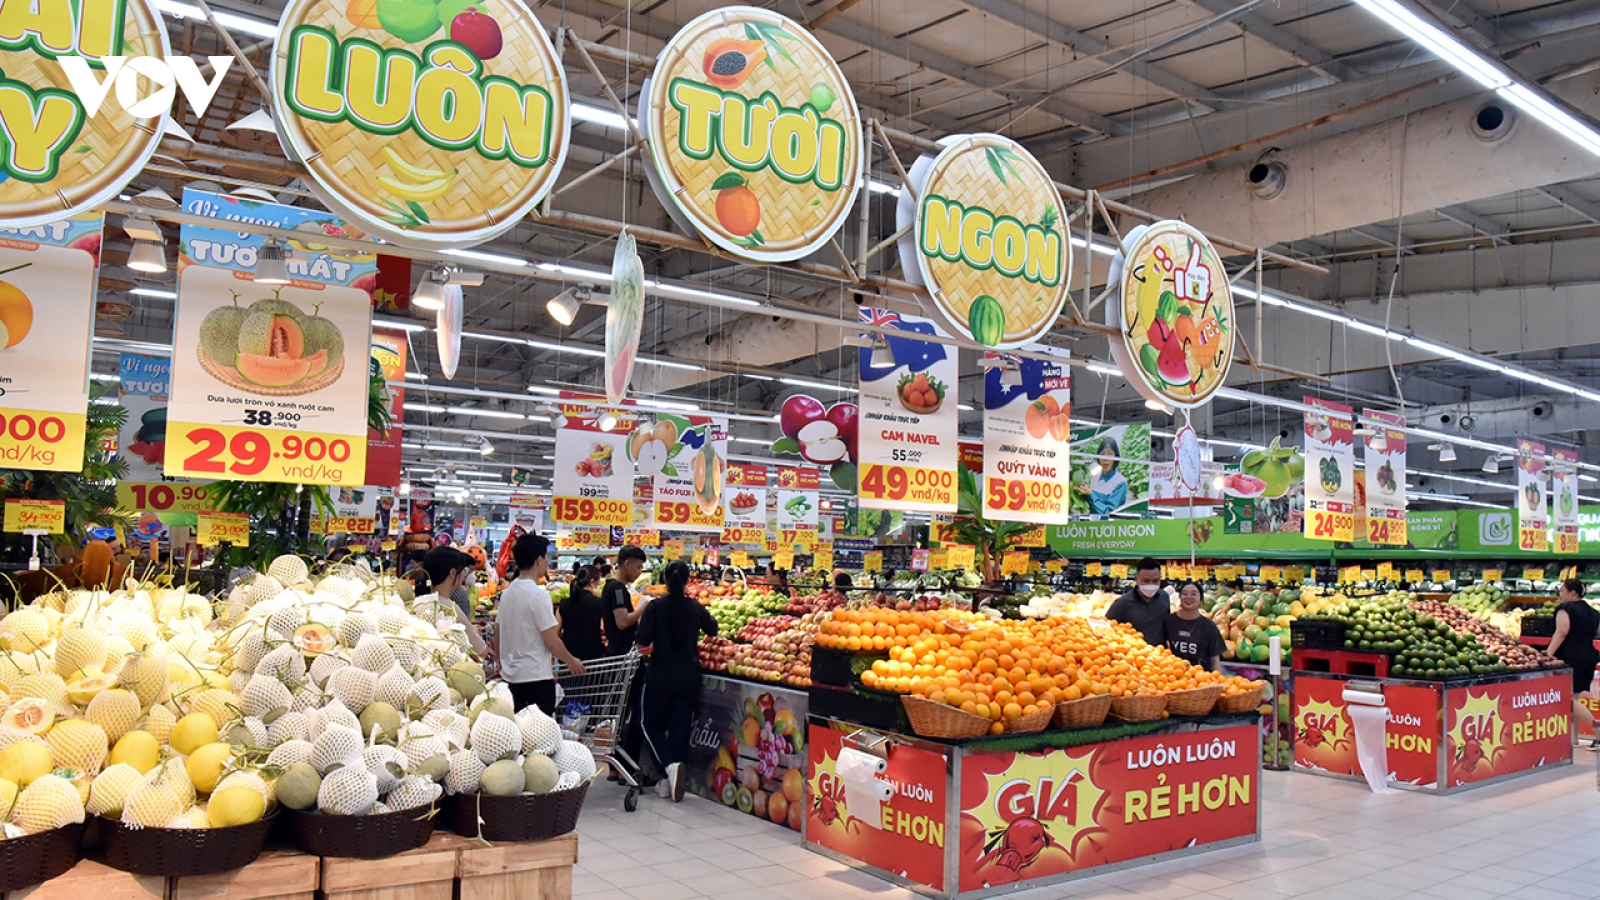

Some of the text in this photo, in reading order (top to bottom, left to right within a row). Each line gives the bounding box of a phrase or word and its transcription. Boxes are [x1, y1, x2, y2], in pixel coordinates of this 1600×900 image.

[287, 27, 551, 166] LUÔN
[671, 79, 844, 189] TƯƠI
[921, 196, 1059, 286] NGON
[277, 401, 297, 409] xanh
[243, 409, 302, 426] 38.900
[881, 429, 940, 445] CAM NAVEL
[183, 428, 351, 476] 29.900
[281, 465, 343, 482] vnd/kg
[997, 460, 1057, 478] QUÝT VÀNG
[861, 465, 953, 500] 49.000
[988, 478, 1063, 511] 59.000
[554, 498, 628, 522] 159.000
[1056, 523, 1156, 538] LUÔN TƯƠI NGON
[1314, 513, 1352, 537] 24.900
[1370, 520, 1404, 542] 24.900
[1072, 540, 1136, 549] FRESH EVERYDAY
[1170, 640, 1197, 655] YES
[1512, 688, 1561, 709] LUÔN LUÔN
[1390, 714, 1421, 726] LUÔN
[1460, 709, 1496, 748] GIÁ
[1512, 712, 1568, 745] RẺ HƠN
[1126, 737, 1236, 770] LUÔN LUÔN
[1386, 732, 1432, 754] HƠN
[902, 782, 933, 804] LUÔN
[994, 768, 1086, 827] GIÁ
[1124, 773, 1251, 823] RẺ HƠN
[897, 810, 944, 848] HƠN
